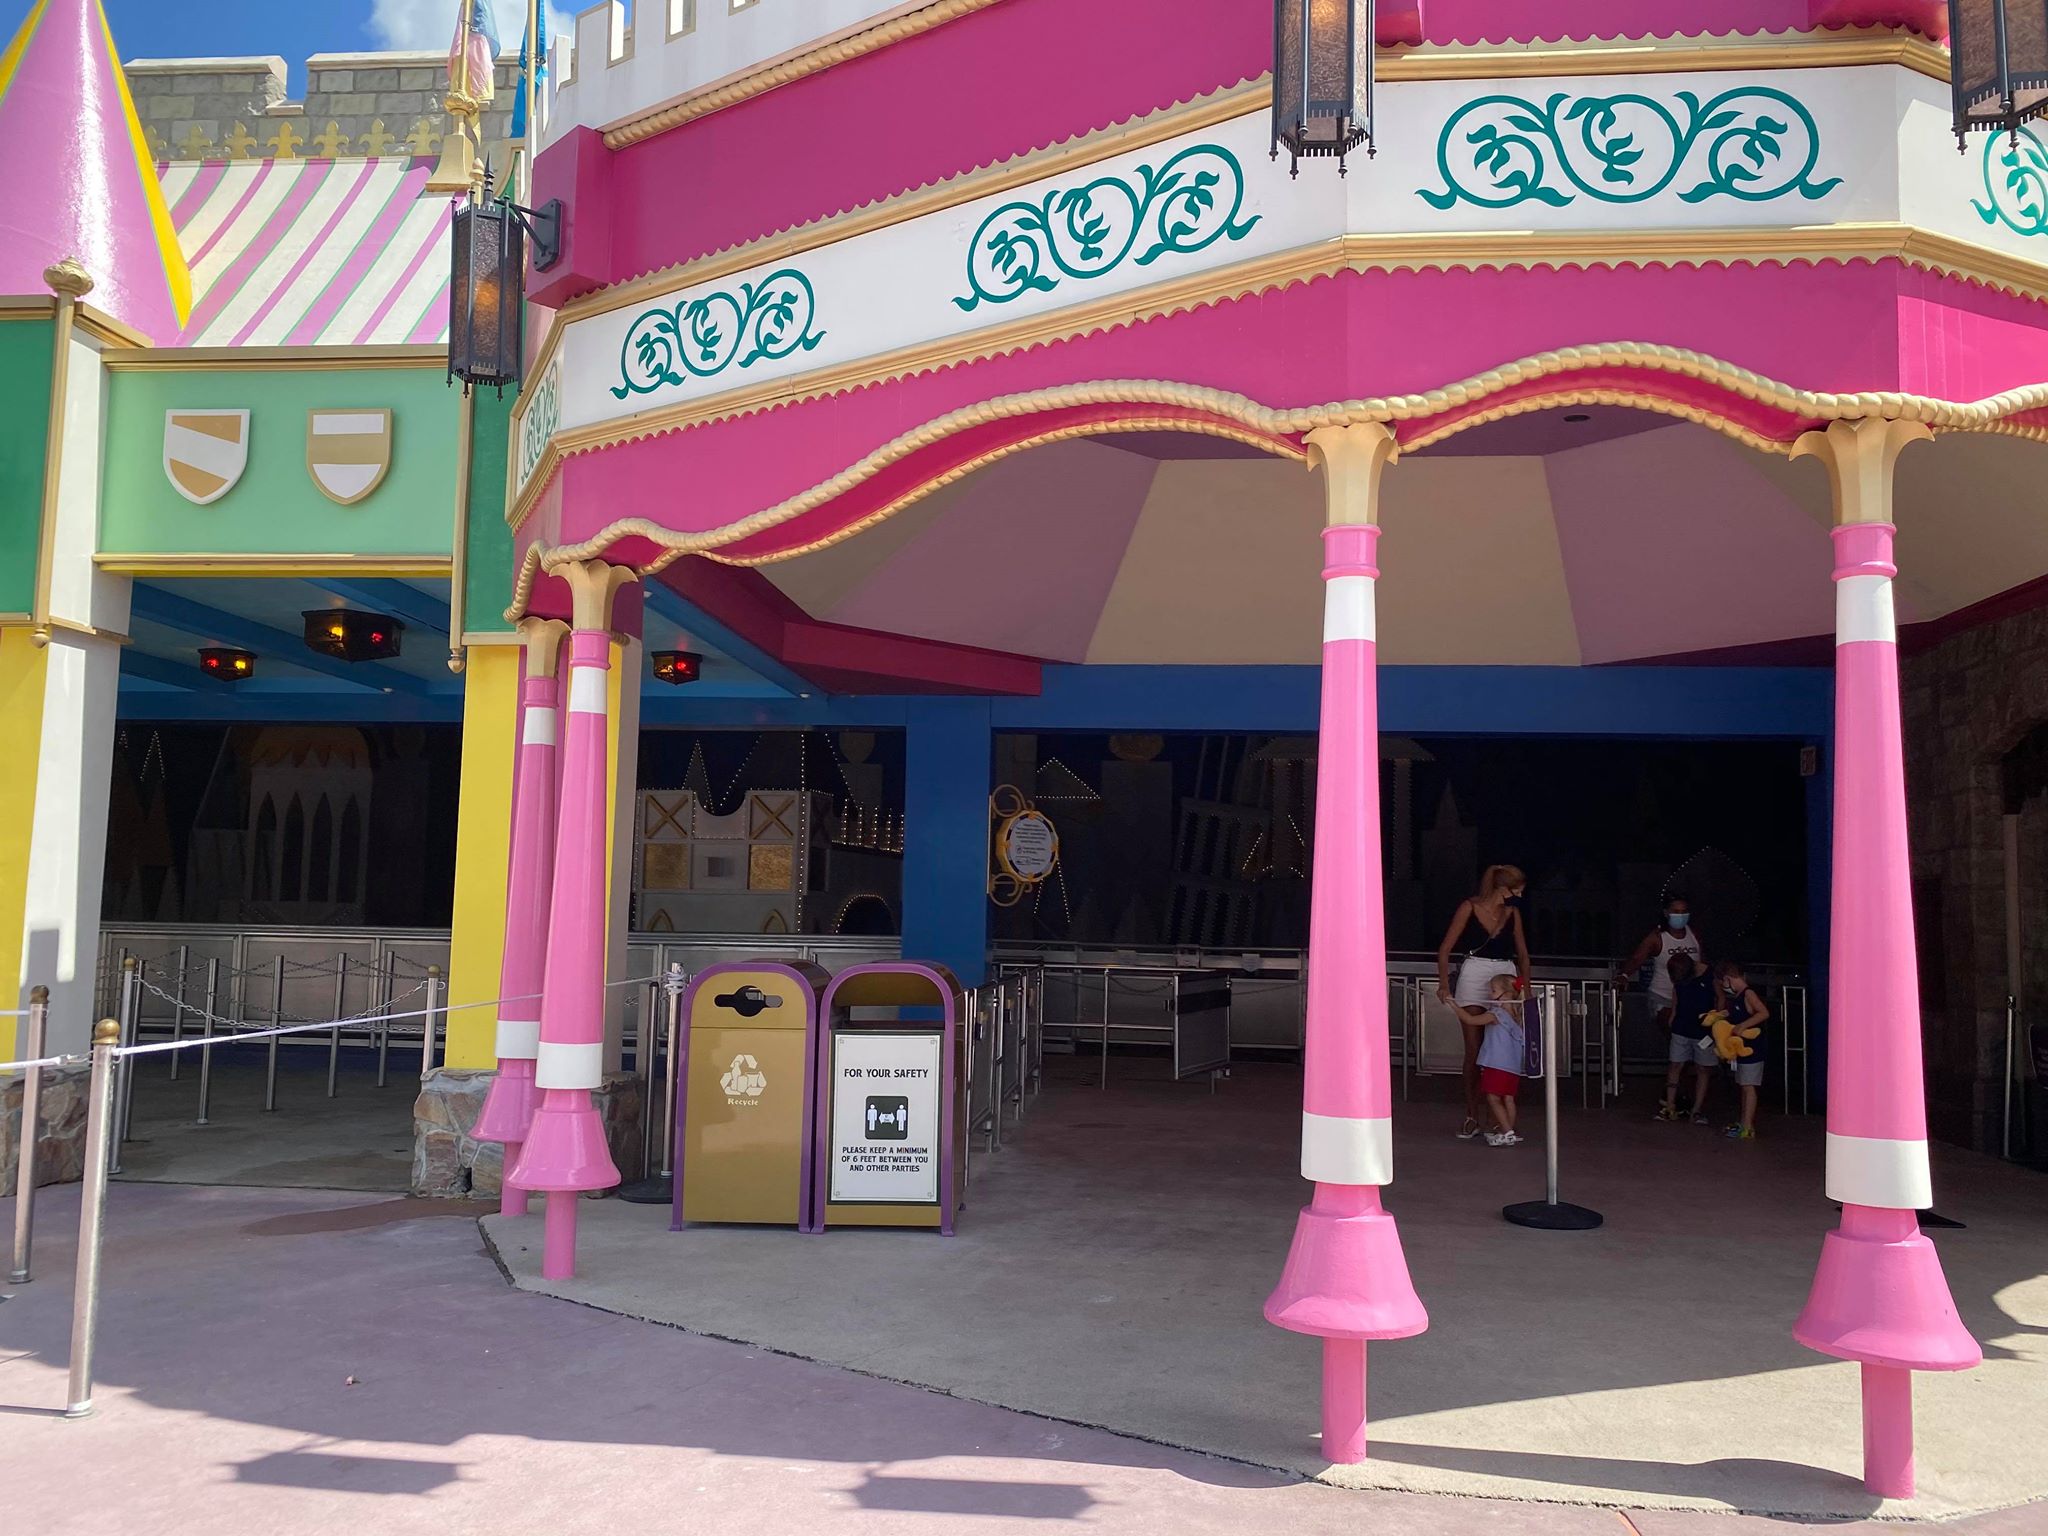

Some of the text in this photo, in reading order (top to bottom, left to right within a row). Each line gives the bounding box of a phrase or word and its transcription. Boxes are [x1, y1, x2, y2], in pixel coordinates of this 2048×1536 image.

[844, 1068, 929, 1078] FOR YOUR SAFETY
[727, 1098, 759, 1106] Recycle
[896, 1147, 928, 1155] MINIMUM
[878, 1156, 912, 1164] BETWEEN
[914, 1156, 929, 1164] YOU
[891, 1165, 920, 1173] PARTIES
